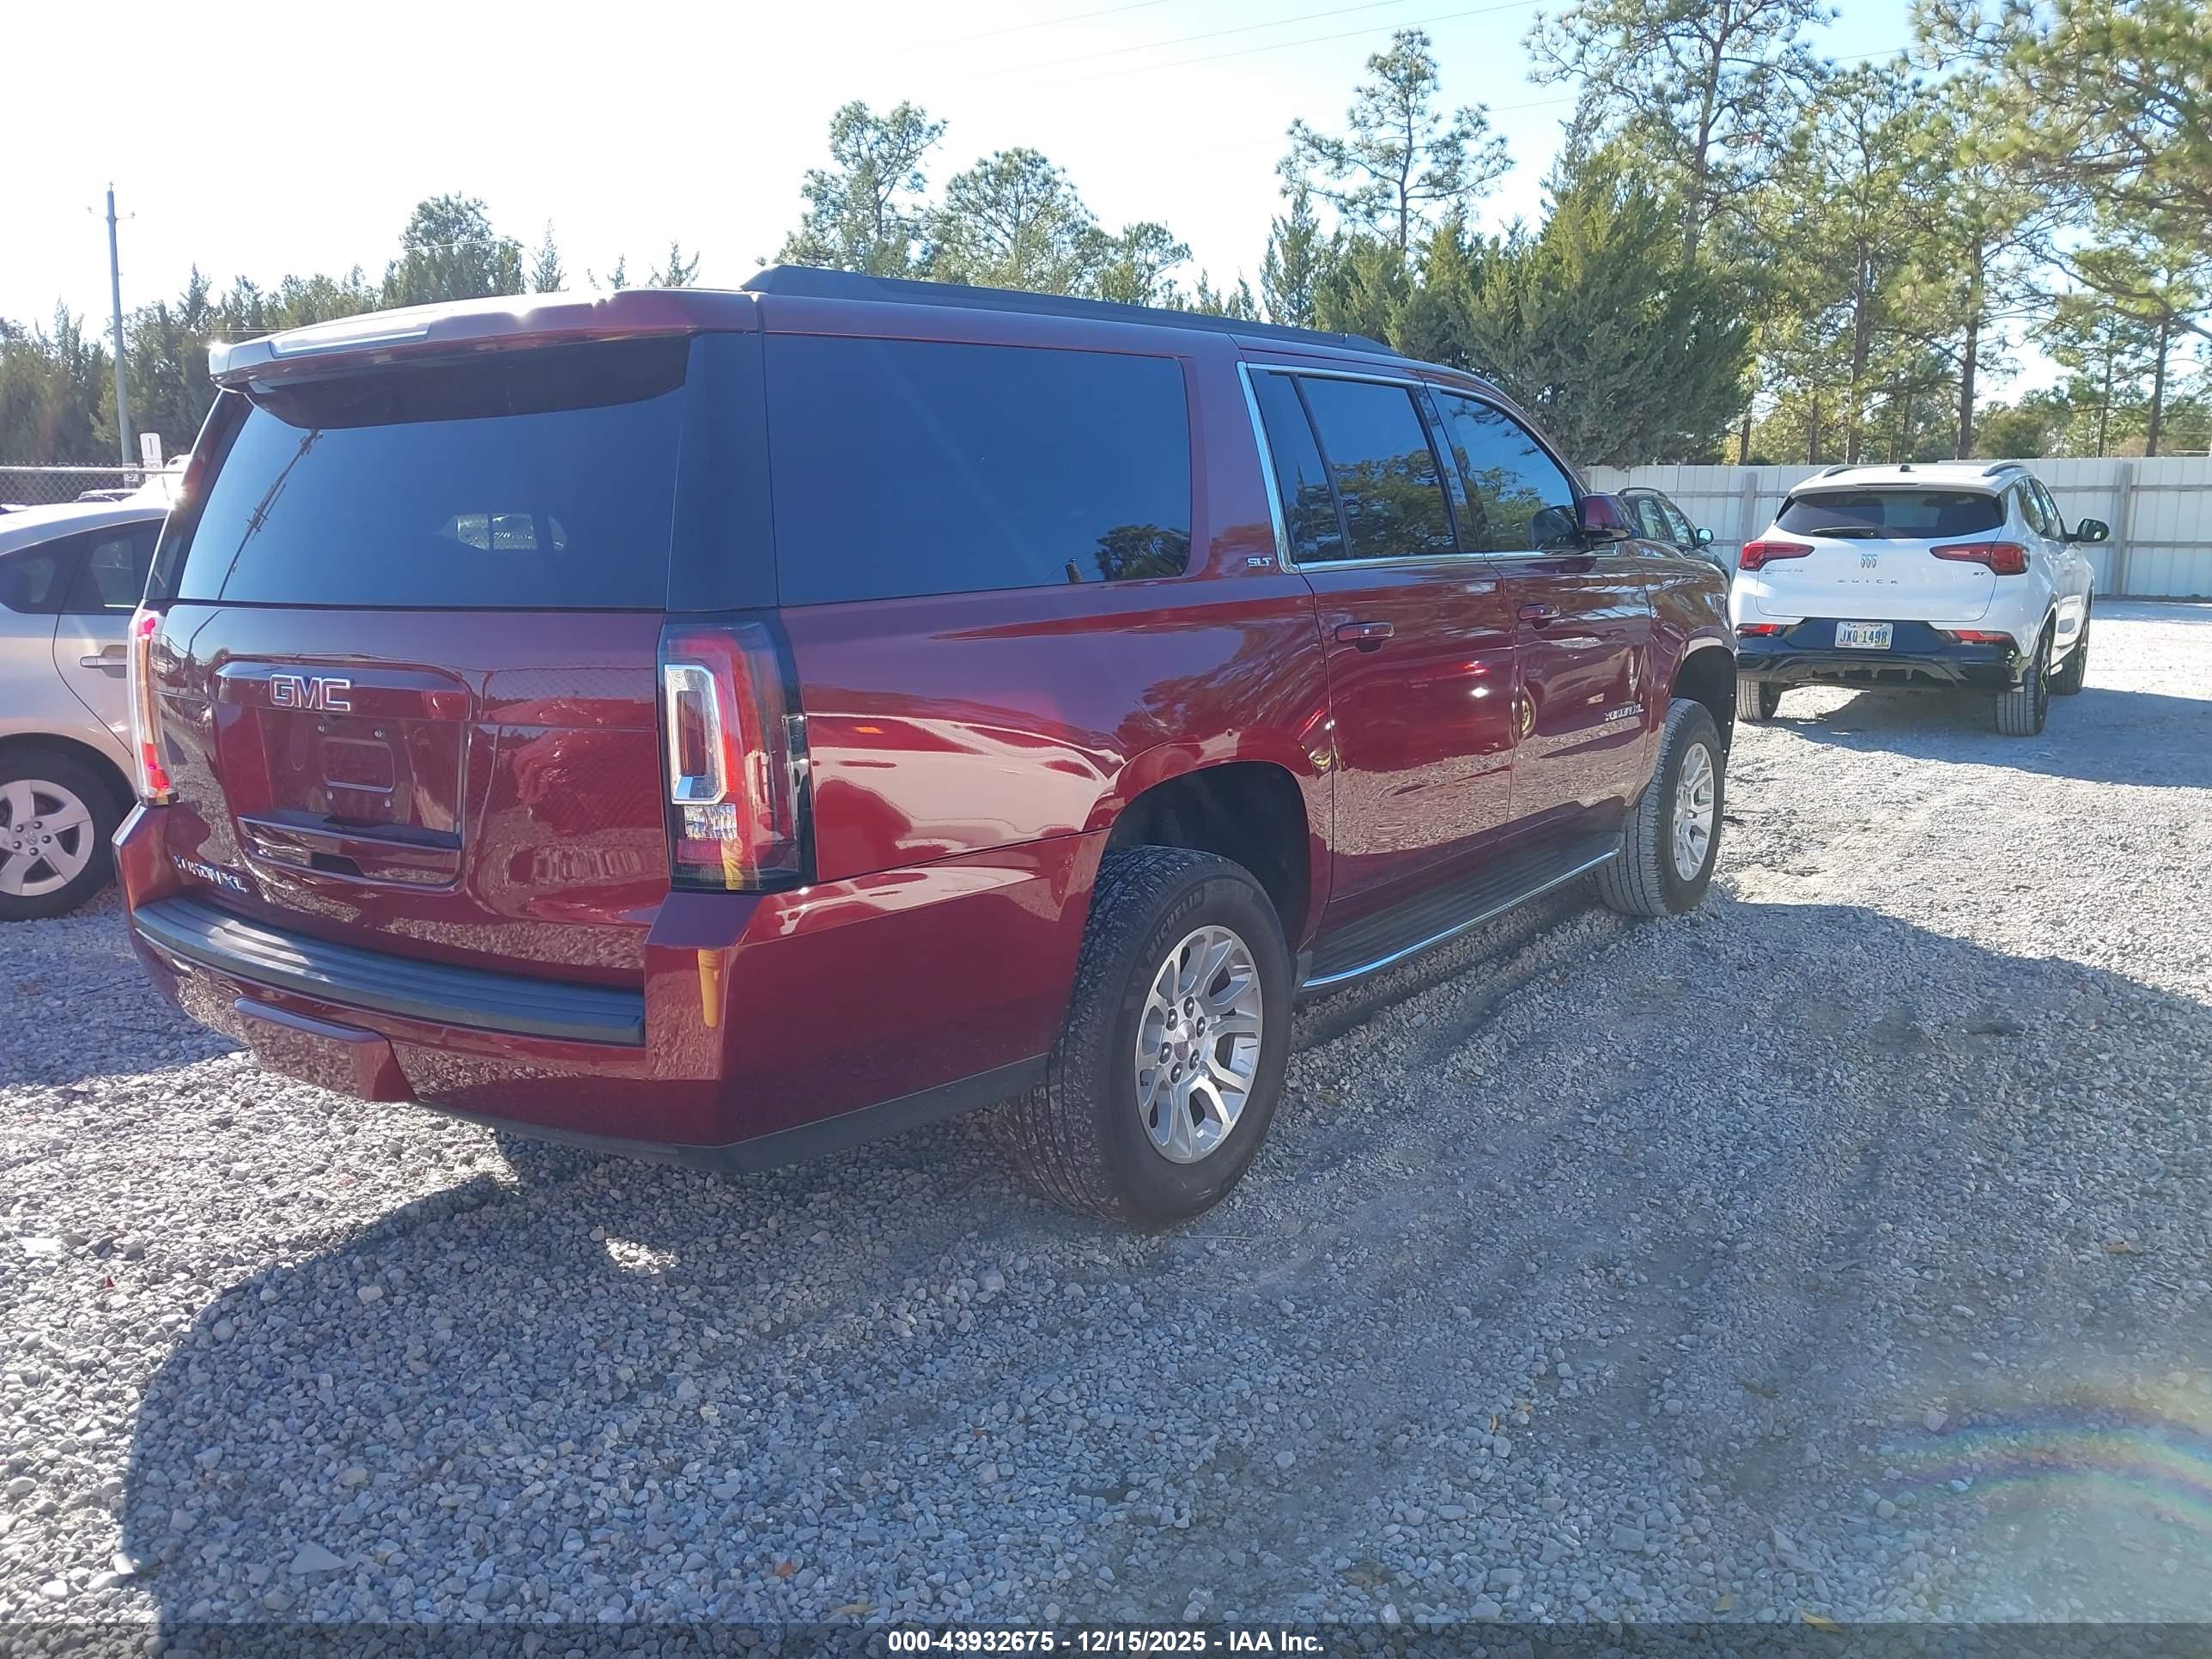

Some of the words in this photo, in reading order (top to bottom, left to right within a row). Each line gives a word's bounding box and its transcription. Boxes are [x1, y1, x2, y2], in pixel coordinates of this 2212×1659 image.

[1247, 557, 1272, 568] SLT
[1862, 630, 1887, 644] 1498
[270, 674, 350, 712] GMC
[1146, 887, 1205, 962] MICHELIN
